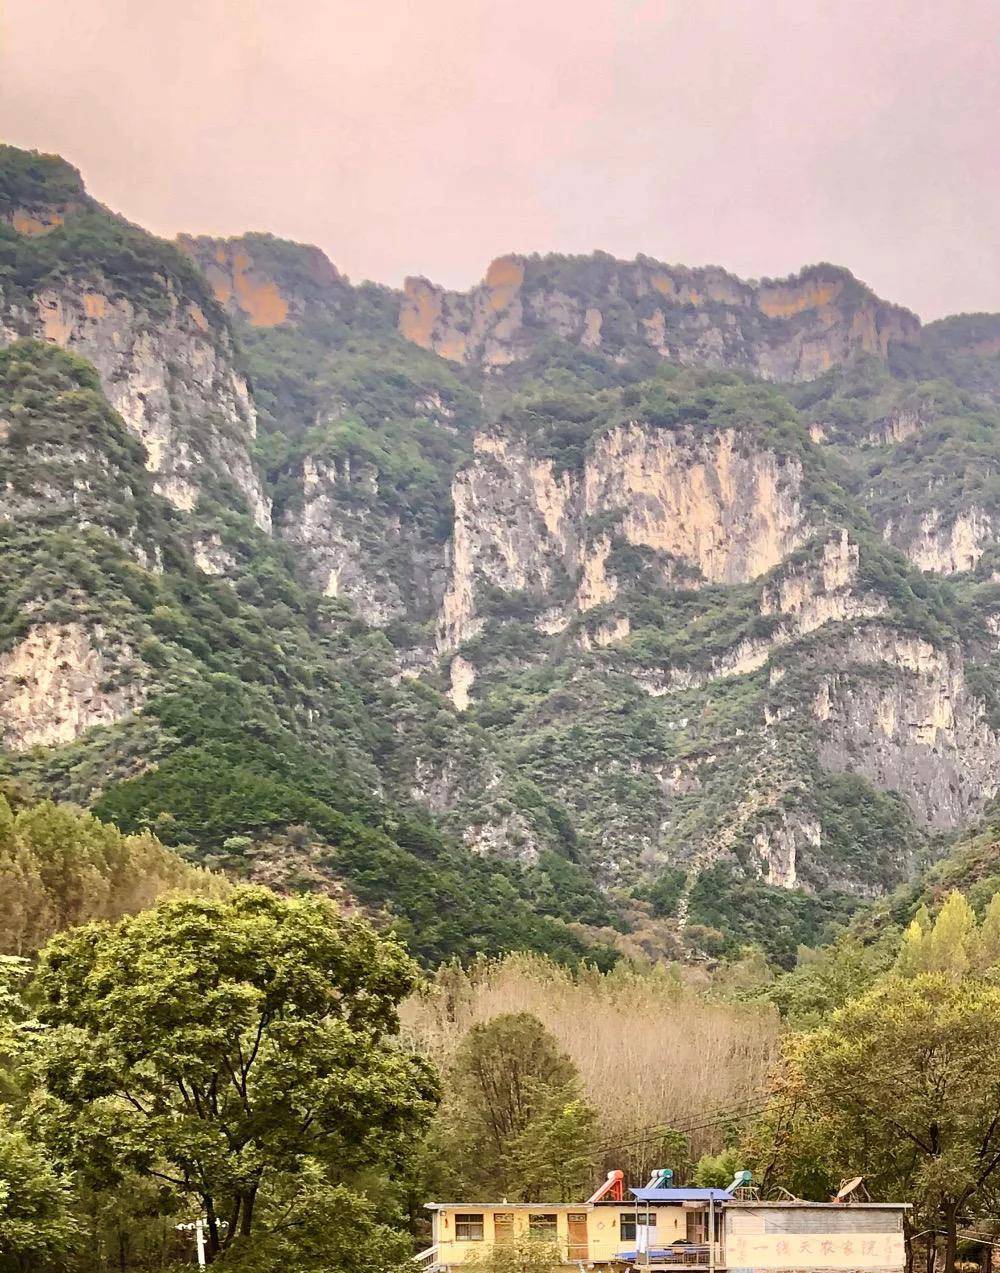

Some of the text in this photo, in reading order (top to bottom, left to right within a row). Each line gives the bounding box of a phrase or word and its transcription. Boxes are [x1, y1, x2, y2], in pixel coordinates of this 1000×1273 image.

[753, 1239, 878, 1256] 一线天农家院
